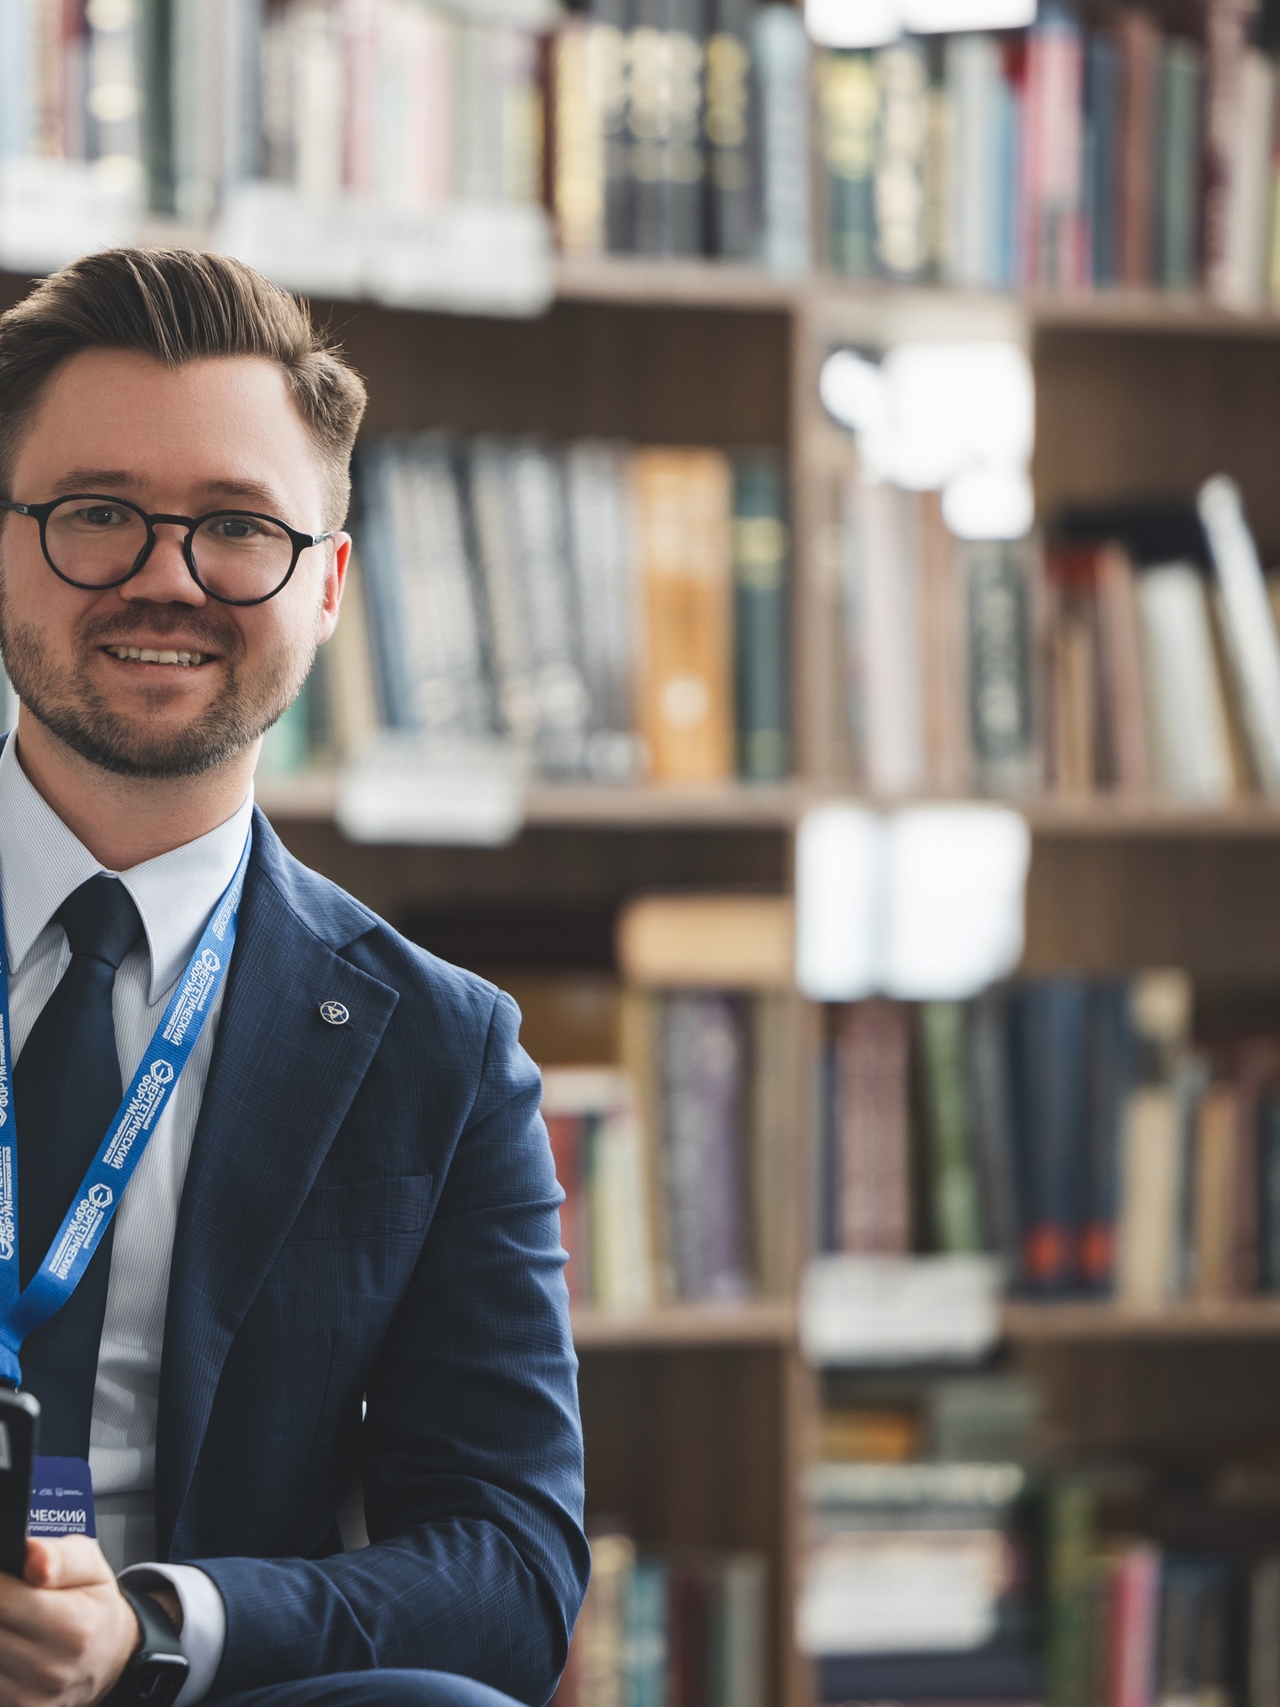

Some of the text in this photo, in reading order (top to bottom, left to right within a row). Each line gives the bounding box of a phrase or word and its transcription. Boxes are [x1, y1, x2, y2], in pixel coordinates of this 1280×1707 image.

[182, 960, 203, 997] ФОРУМ
[125, 1074, 151, 1116] ФОРУМ
[142, 1087, 166, 1131] РЕГИОНАЛЬНЫЙ
[3, 1200, 15, 1242] ФОРУМ
[67, 1198, 90, 1238] ФОРУМ
[28, 1509, 86, 1523] ЧЕСКИЙ
[68, 1524, 86, 1533] КРАЙ
